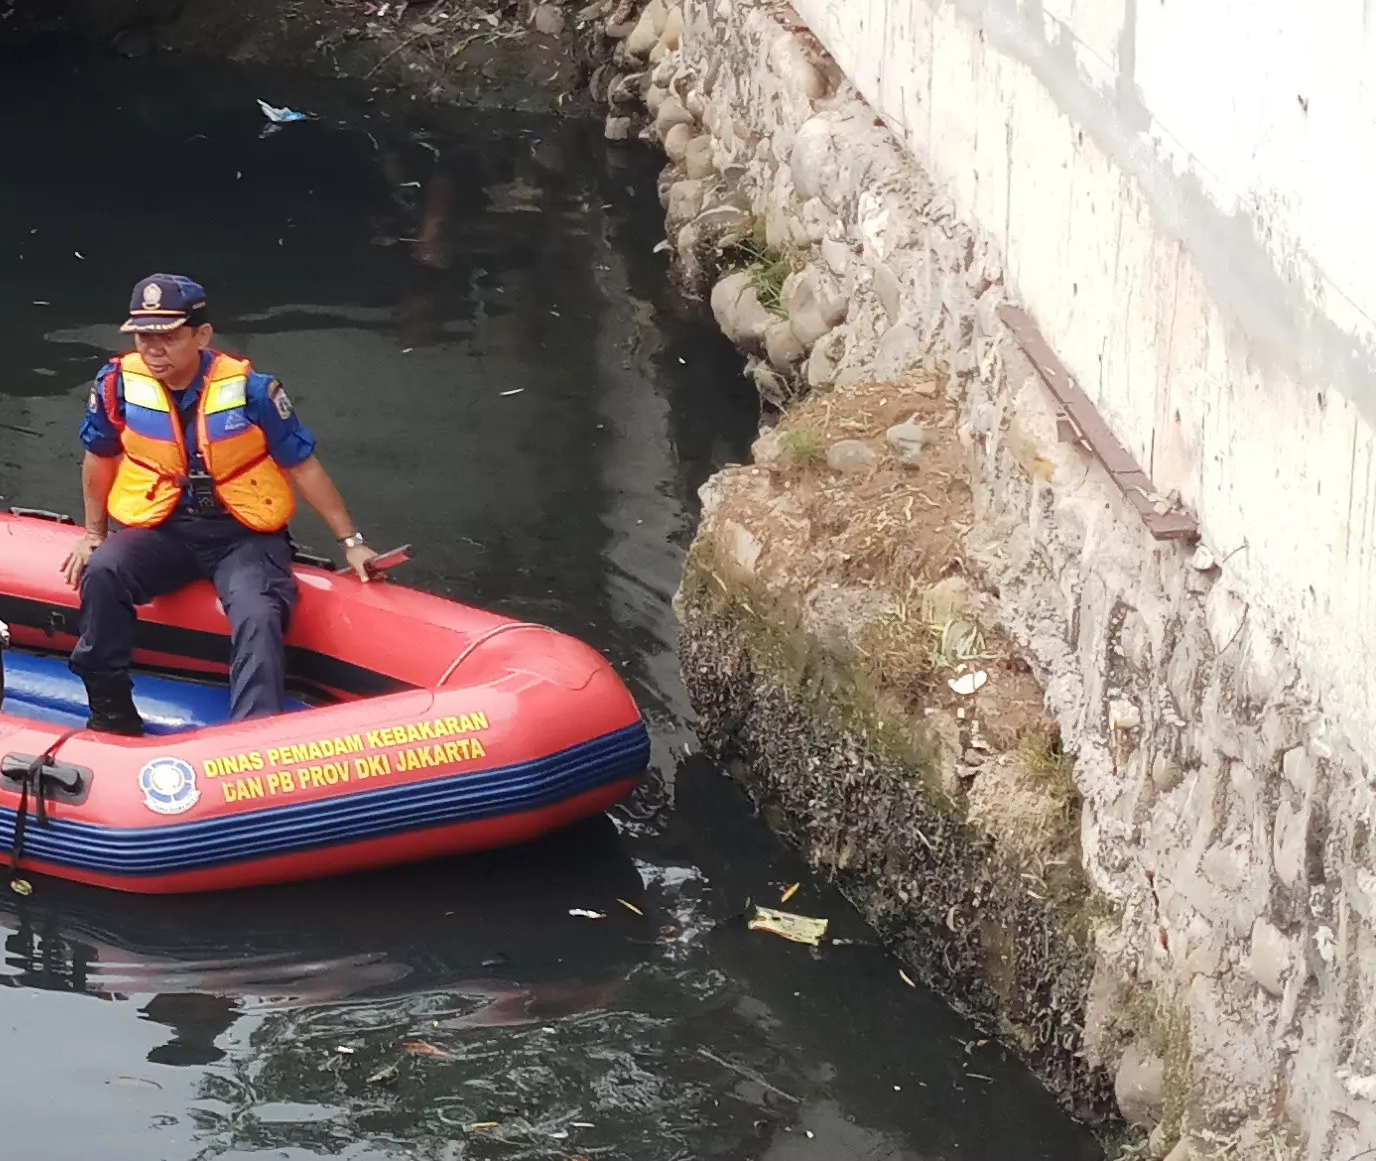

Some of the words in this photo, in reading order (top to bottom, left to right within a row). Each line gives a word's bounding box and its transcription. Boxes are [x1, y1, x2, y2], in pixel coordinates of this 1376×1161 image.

[203, 755, 266, 779] DINAS
[268, 734, 365, 767] PEMADAM
[367, 711, 489, 749] KEBAKARAN
[268, 773, 295, 795] PB
[298, 762, 351, 790] PROV
[355, 754, 391, 778] DKI
[396, 738, 487, 772] JAKARTA
